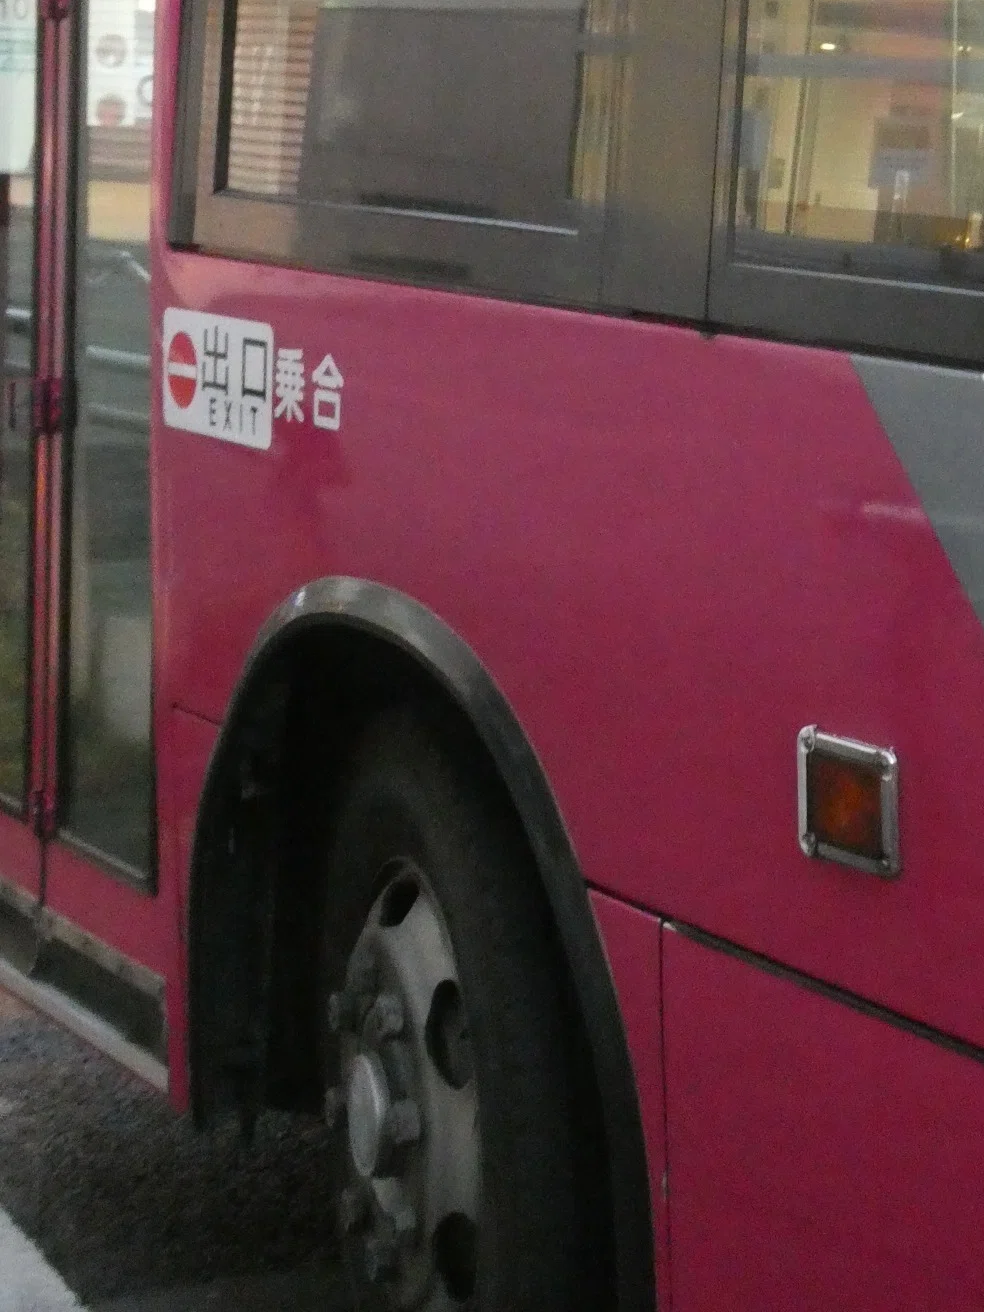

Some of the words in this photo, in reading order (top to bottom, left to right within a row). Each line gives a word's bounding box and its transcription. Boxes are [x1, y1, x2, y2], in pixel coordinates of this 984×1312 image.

[202, 325, 268, 402] 出口
[274, 347, 345, 432] 乗合
[209, 397, 258, 436] EXIT
